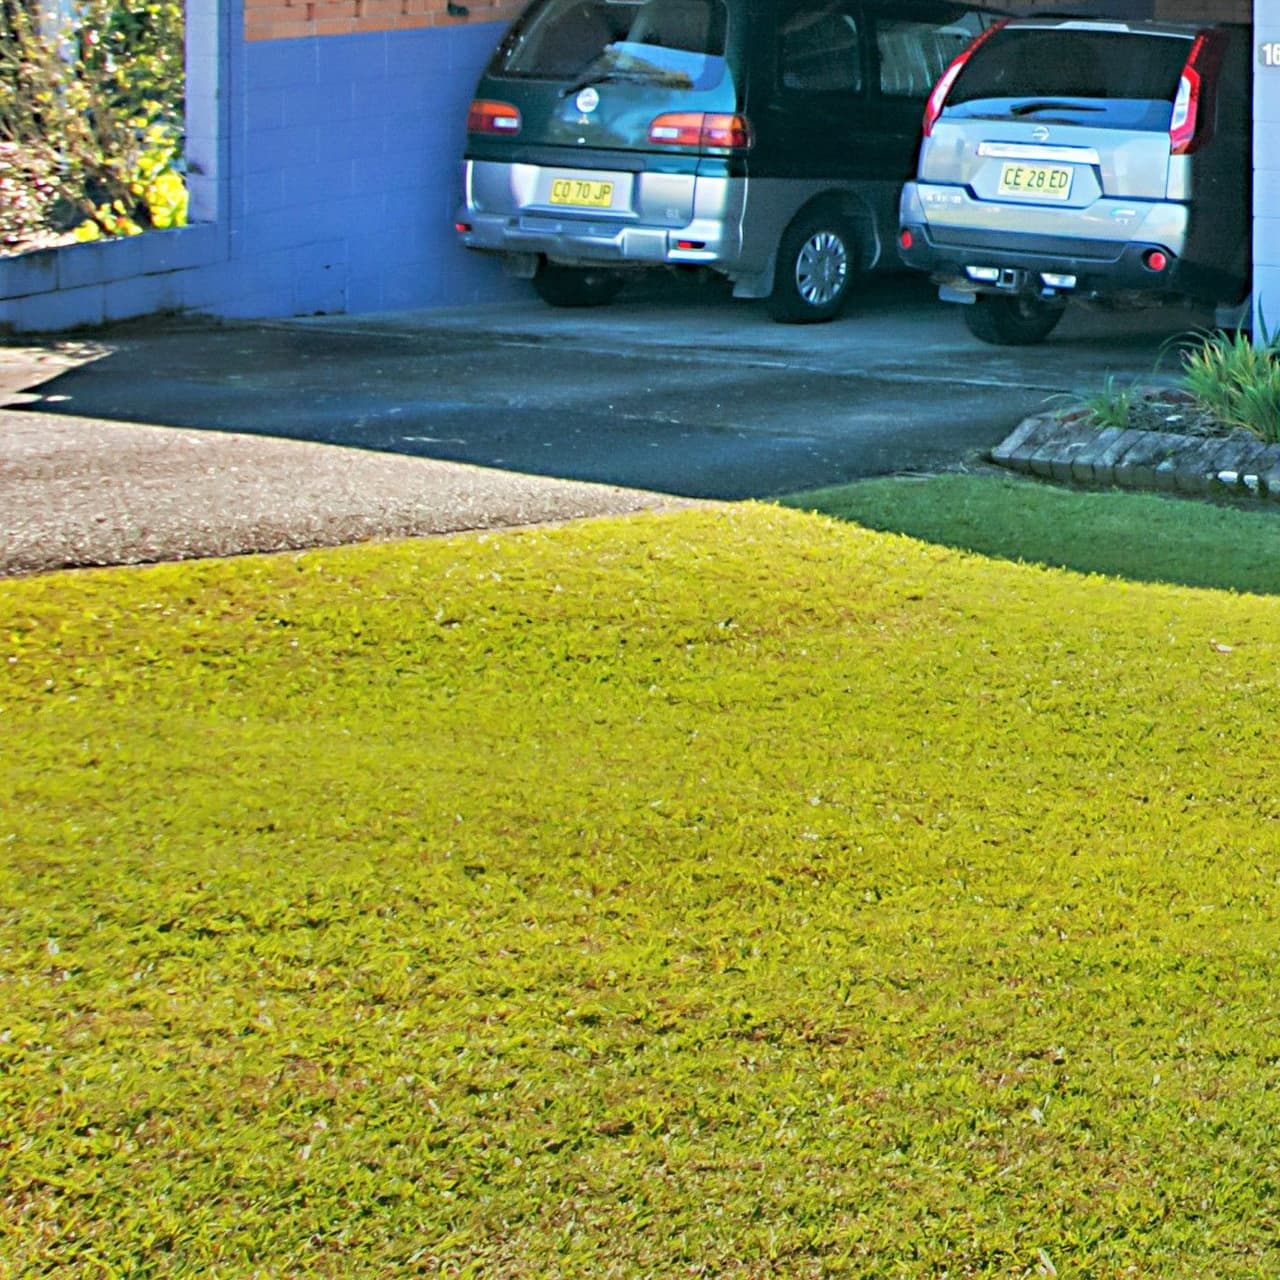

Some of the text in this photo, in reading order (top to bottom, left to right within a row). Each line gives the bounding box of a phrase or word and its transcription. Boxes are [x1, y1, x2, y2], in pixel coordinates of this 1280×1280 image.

[1004, 168, 1069, 188] CE 28 ED
[575, 182, 591, 199] 70
[594, 184, 612, 200] JP
